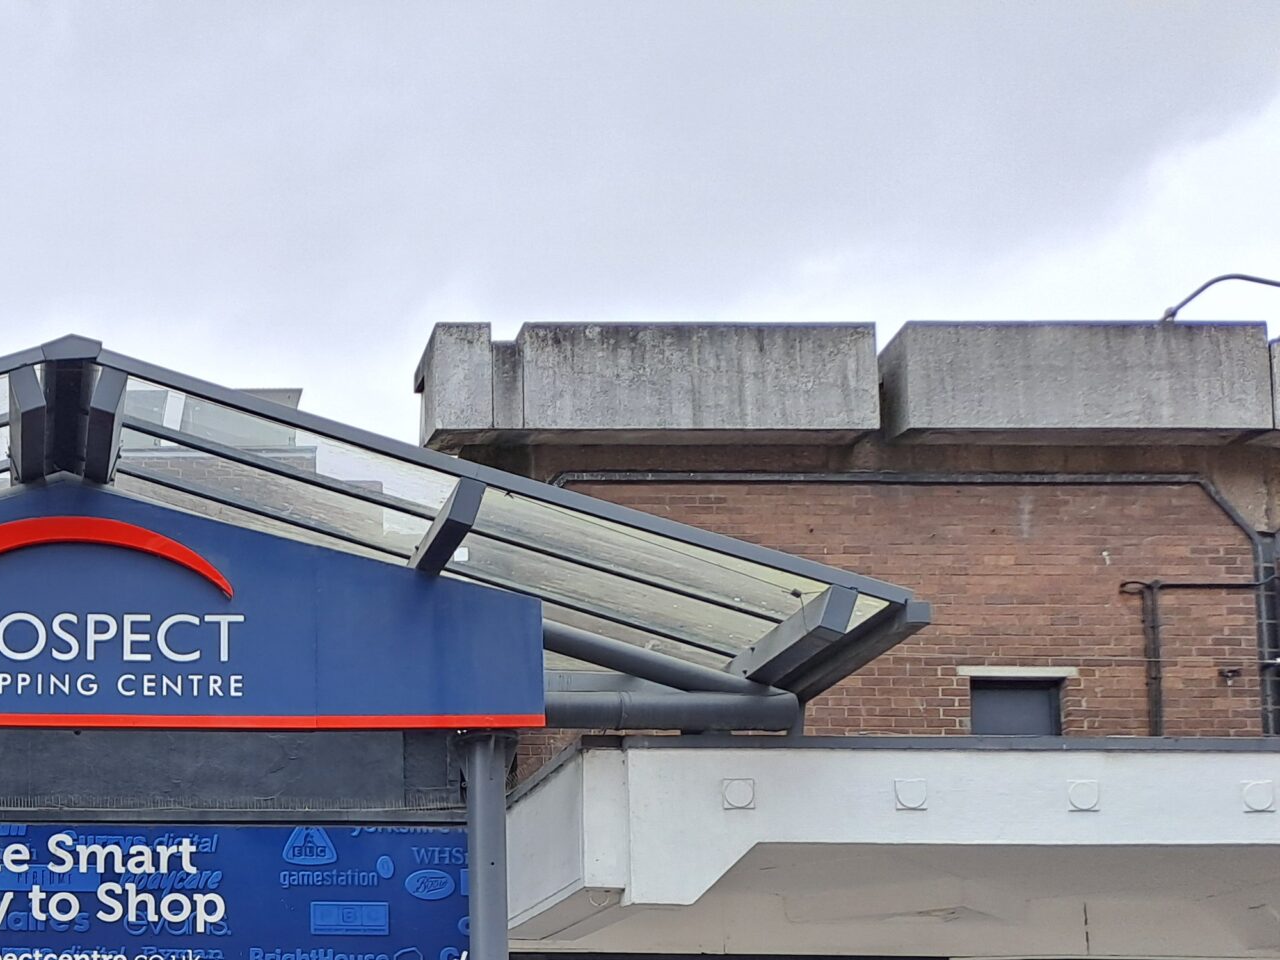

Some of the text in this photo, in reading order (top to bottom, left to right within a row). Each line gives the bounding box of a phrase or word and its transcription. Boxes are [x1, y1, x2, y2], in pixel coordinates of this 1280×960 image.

[117, 674, 244, 697] CENTRE
[47, 833, 198, 874] Smart
[412, 847, 468, 865] WHS
[279, 869, 378, 888] gamestation
[28, 885, 80, 923] to
[95, 883, 226, 933] Shop
